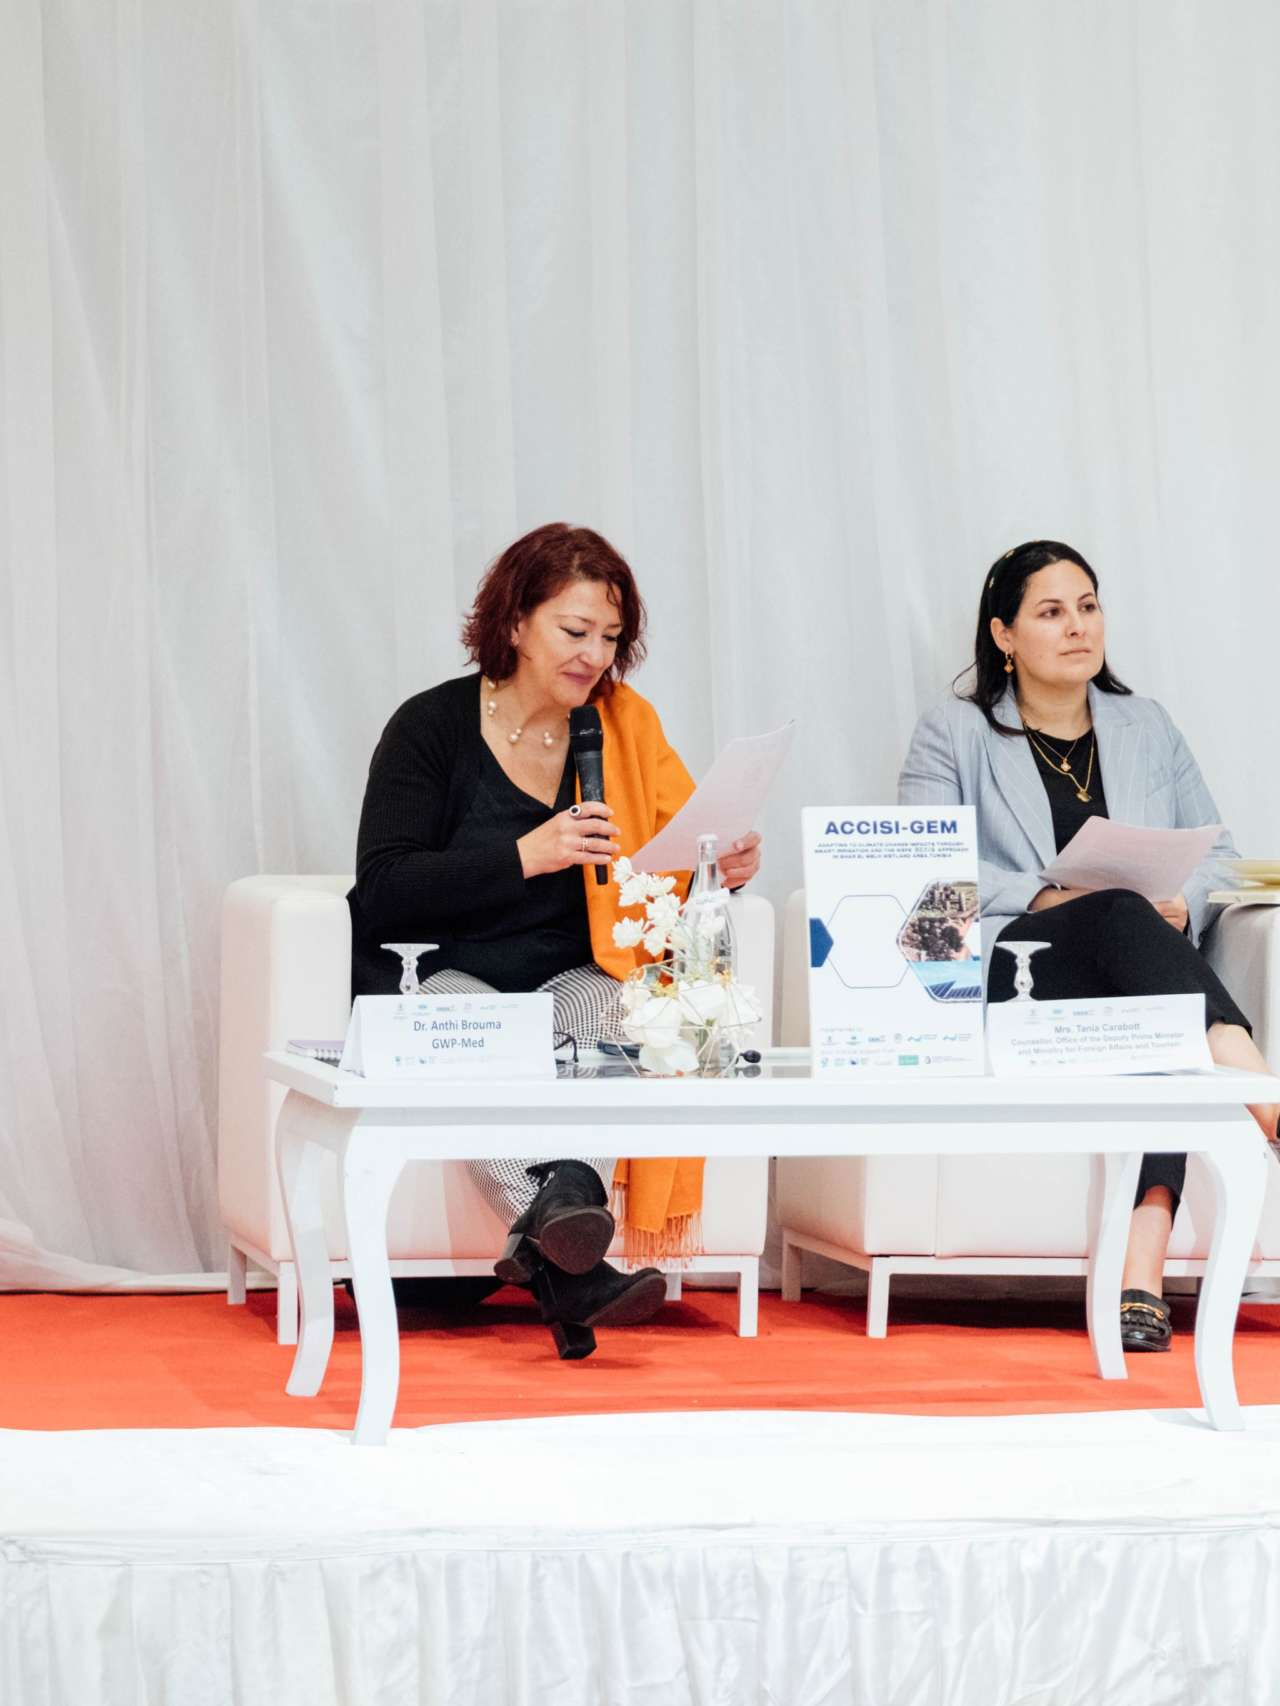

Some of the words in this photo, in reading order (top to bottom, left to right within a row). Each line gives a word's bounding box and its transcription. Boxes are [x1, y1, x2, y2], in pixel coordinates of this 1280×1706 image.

[825, 820, 958, 835] ACCISI-GEM
[413, 1020, 429, 1031] Dr.
[431, 1019, 458, 1031] Anthi
[461, 1019, 502, 1031] Brouma
[1076, 1024, 1100, 1033] Tania
[431, 1036, 485, 1049] GWP-Med
